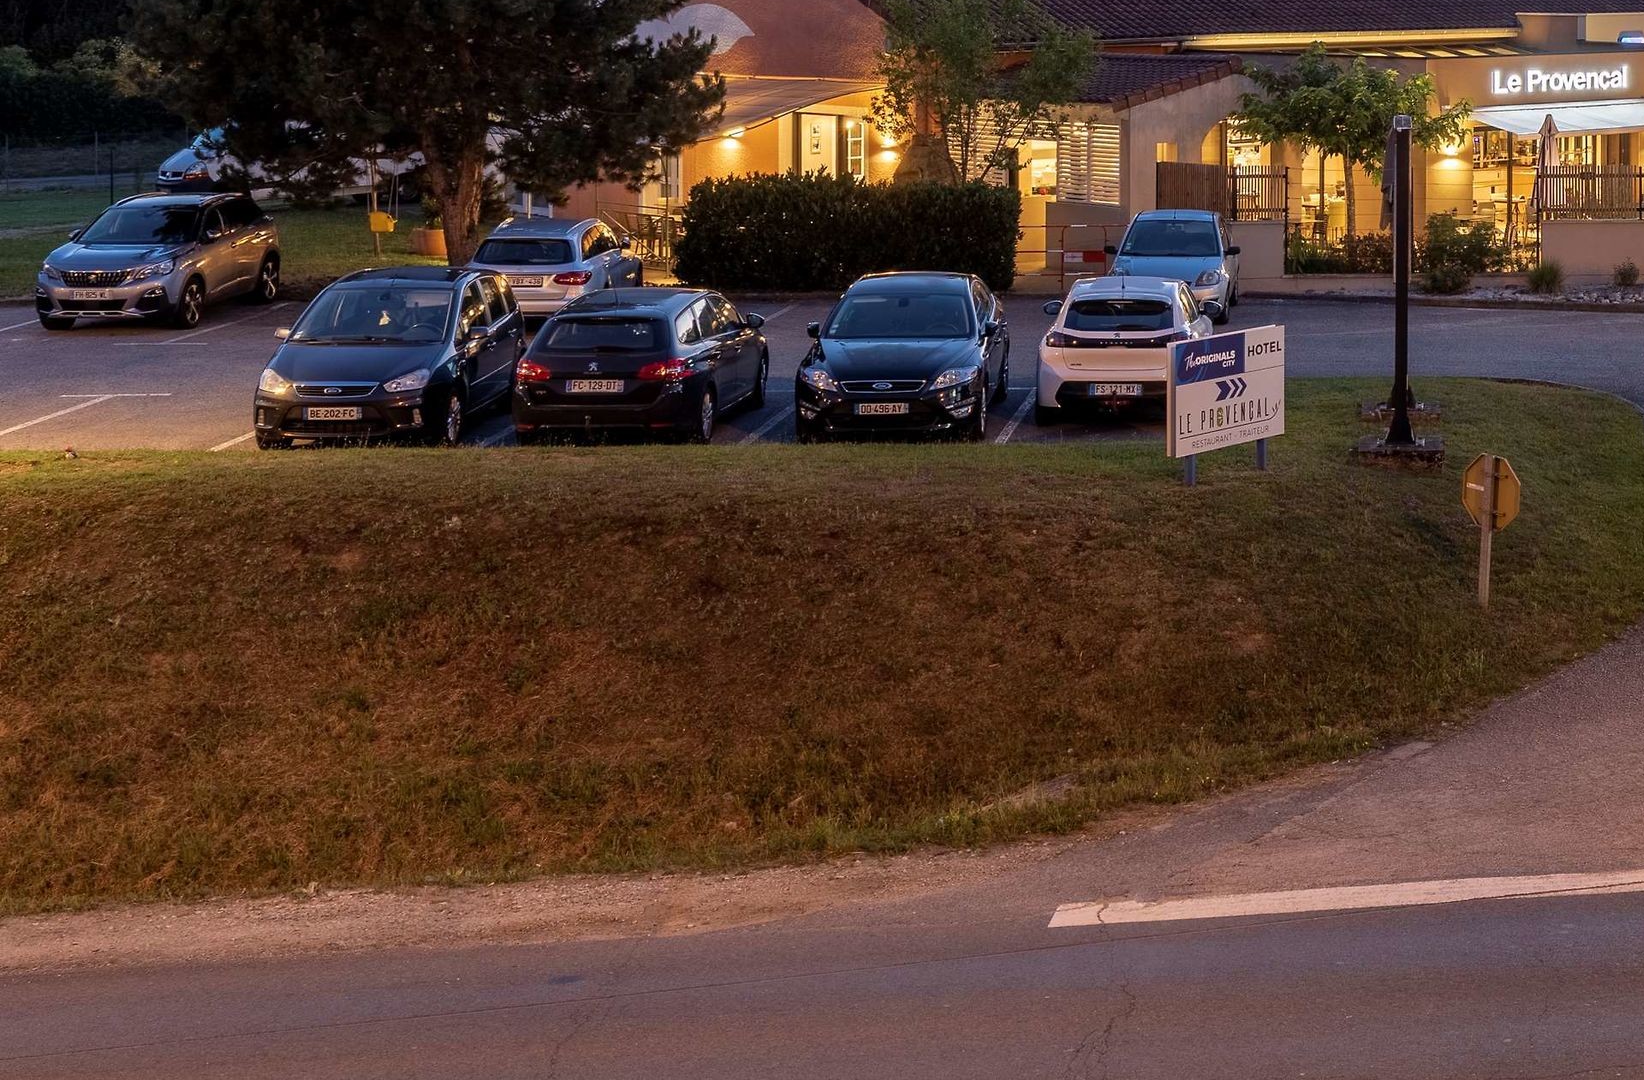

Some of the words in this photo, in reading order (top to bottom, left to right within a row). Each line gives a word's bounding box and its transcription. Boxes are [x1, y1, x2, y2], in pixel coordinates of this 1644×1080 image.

[1492, 69, 1521, 94] Le
[1527, 65, 1628, 93] Provençal
[1248, 341, 1282, 357] HOTEL
[1222, 360, 1235, 368] CITY
[1180, 414, 1192, 435] LE
[1201, 398, 1269, 430] PROVENÇAL
[1192, 433, 1232, 448] RESTAURANT
[1240, 426, 1270, 438] TRAITEUR
